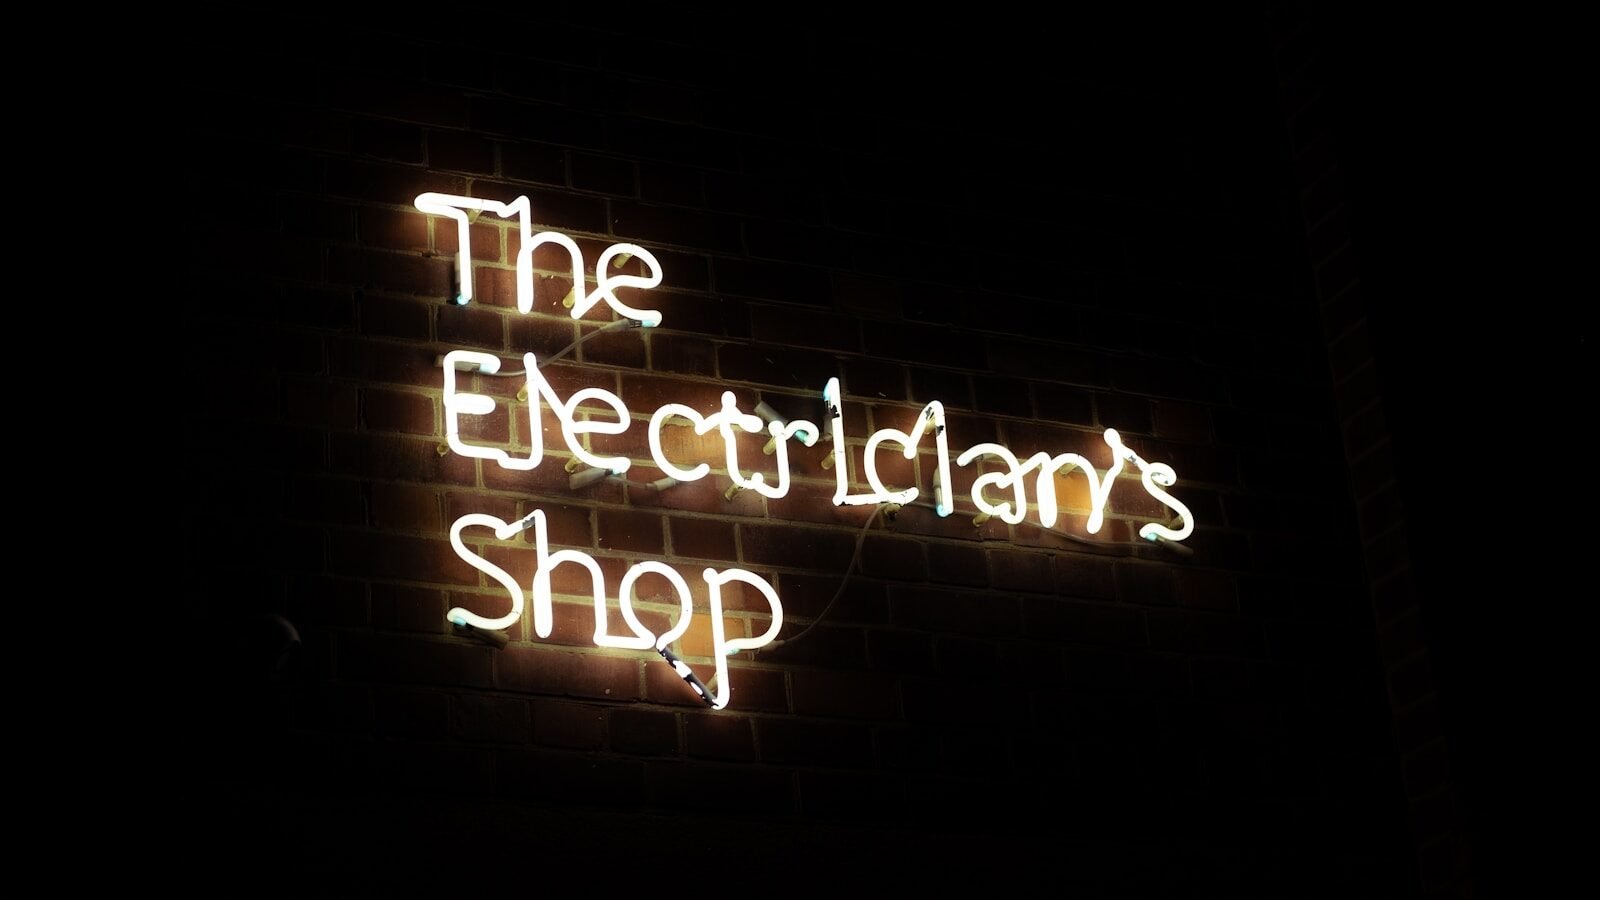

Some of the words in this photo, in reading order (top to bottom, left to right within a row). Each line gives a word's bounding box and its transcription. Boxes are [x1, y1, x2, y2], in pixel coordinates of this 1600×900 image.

[414, 192, 664, 327] The
[442, 350, 1195, 542] Electrician's
[447, 508, 784, 710] Shop
